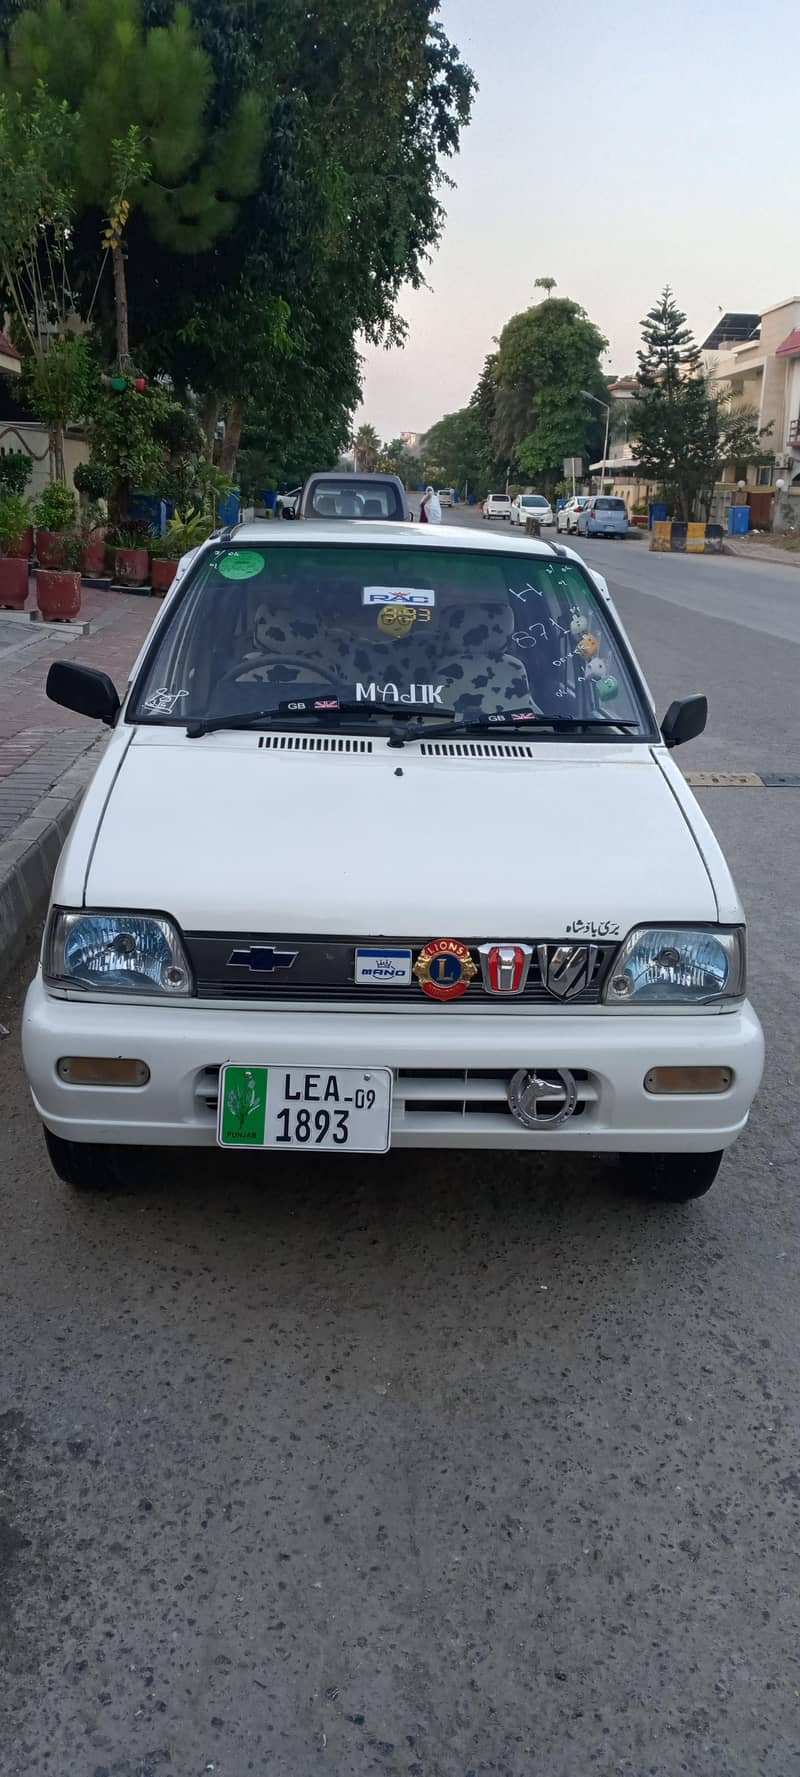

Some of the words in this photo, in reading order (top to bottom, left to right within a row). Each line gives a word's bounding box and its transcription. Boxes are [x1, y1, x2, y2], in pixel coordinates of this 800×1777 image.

[369, 594, 429, 603] RAC
[287, 702, 306, 711] GB
[488, 714, 506, 722] GB
[427, 941, 464, 955] LIONS
[361, 967, 406, 977] MANO
[437, 958, 454, 982] L
[276, 1108, 350, 1144] 1893
